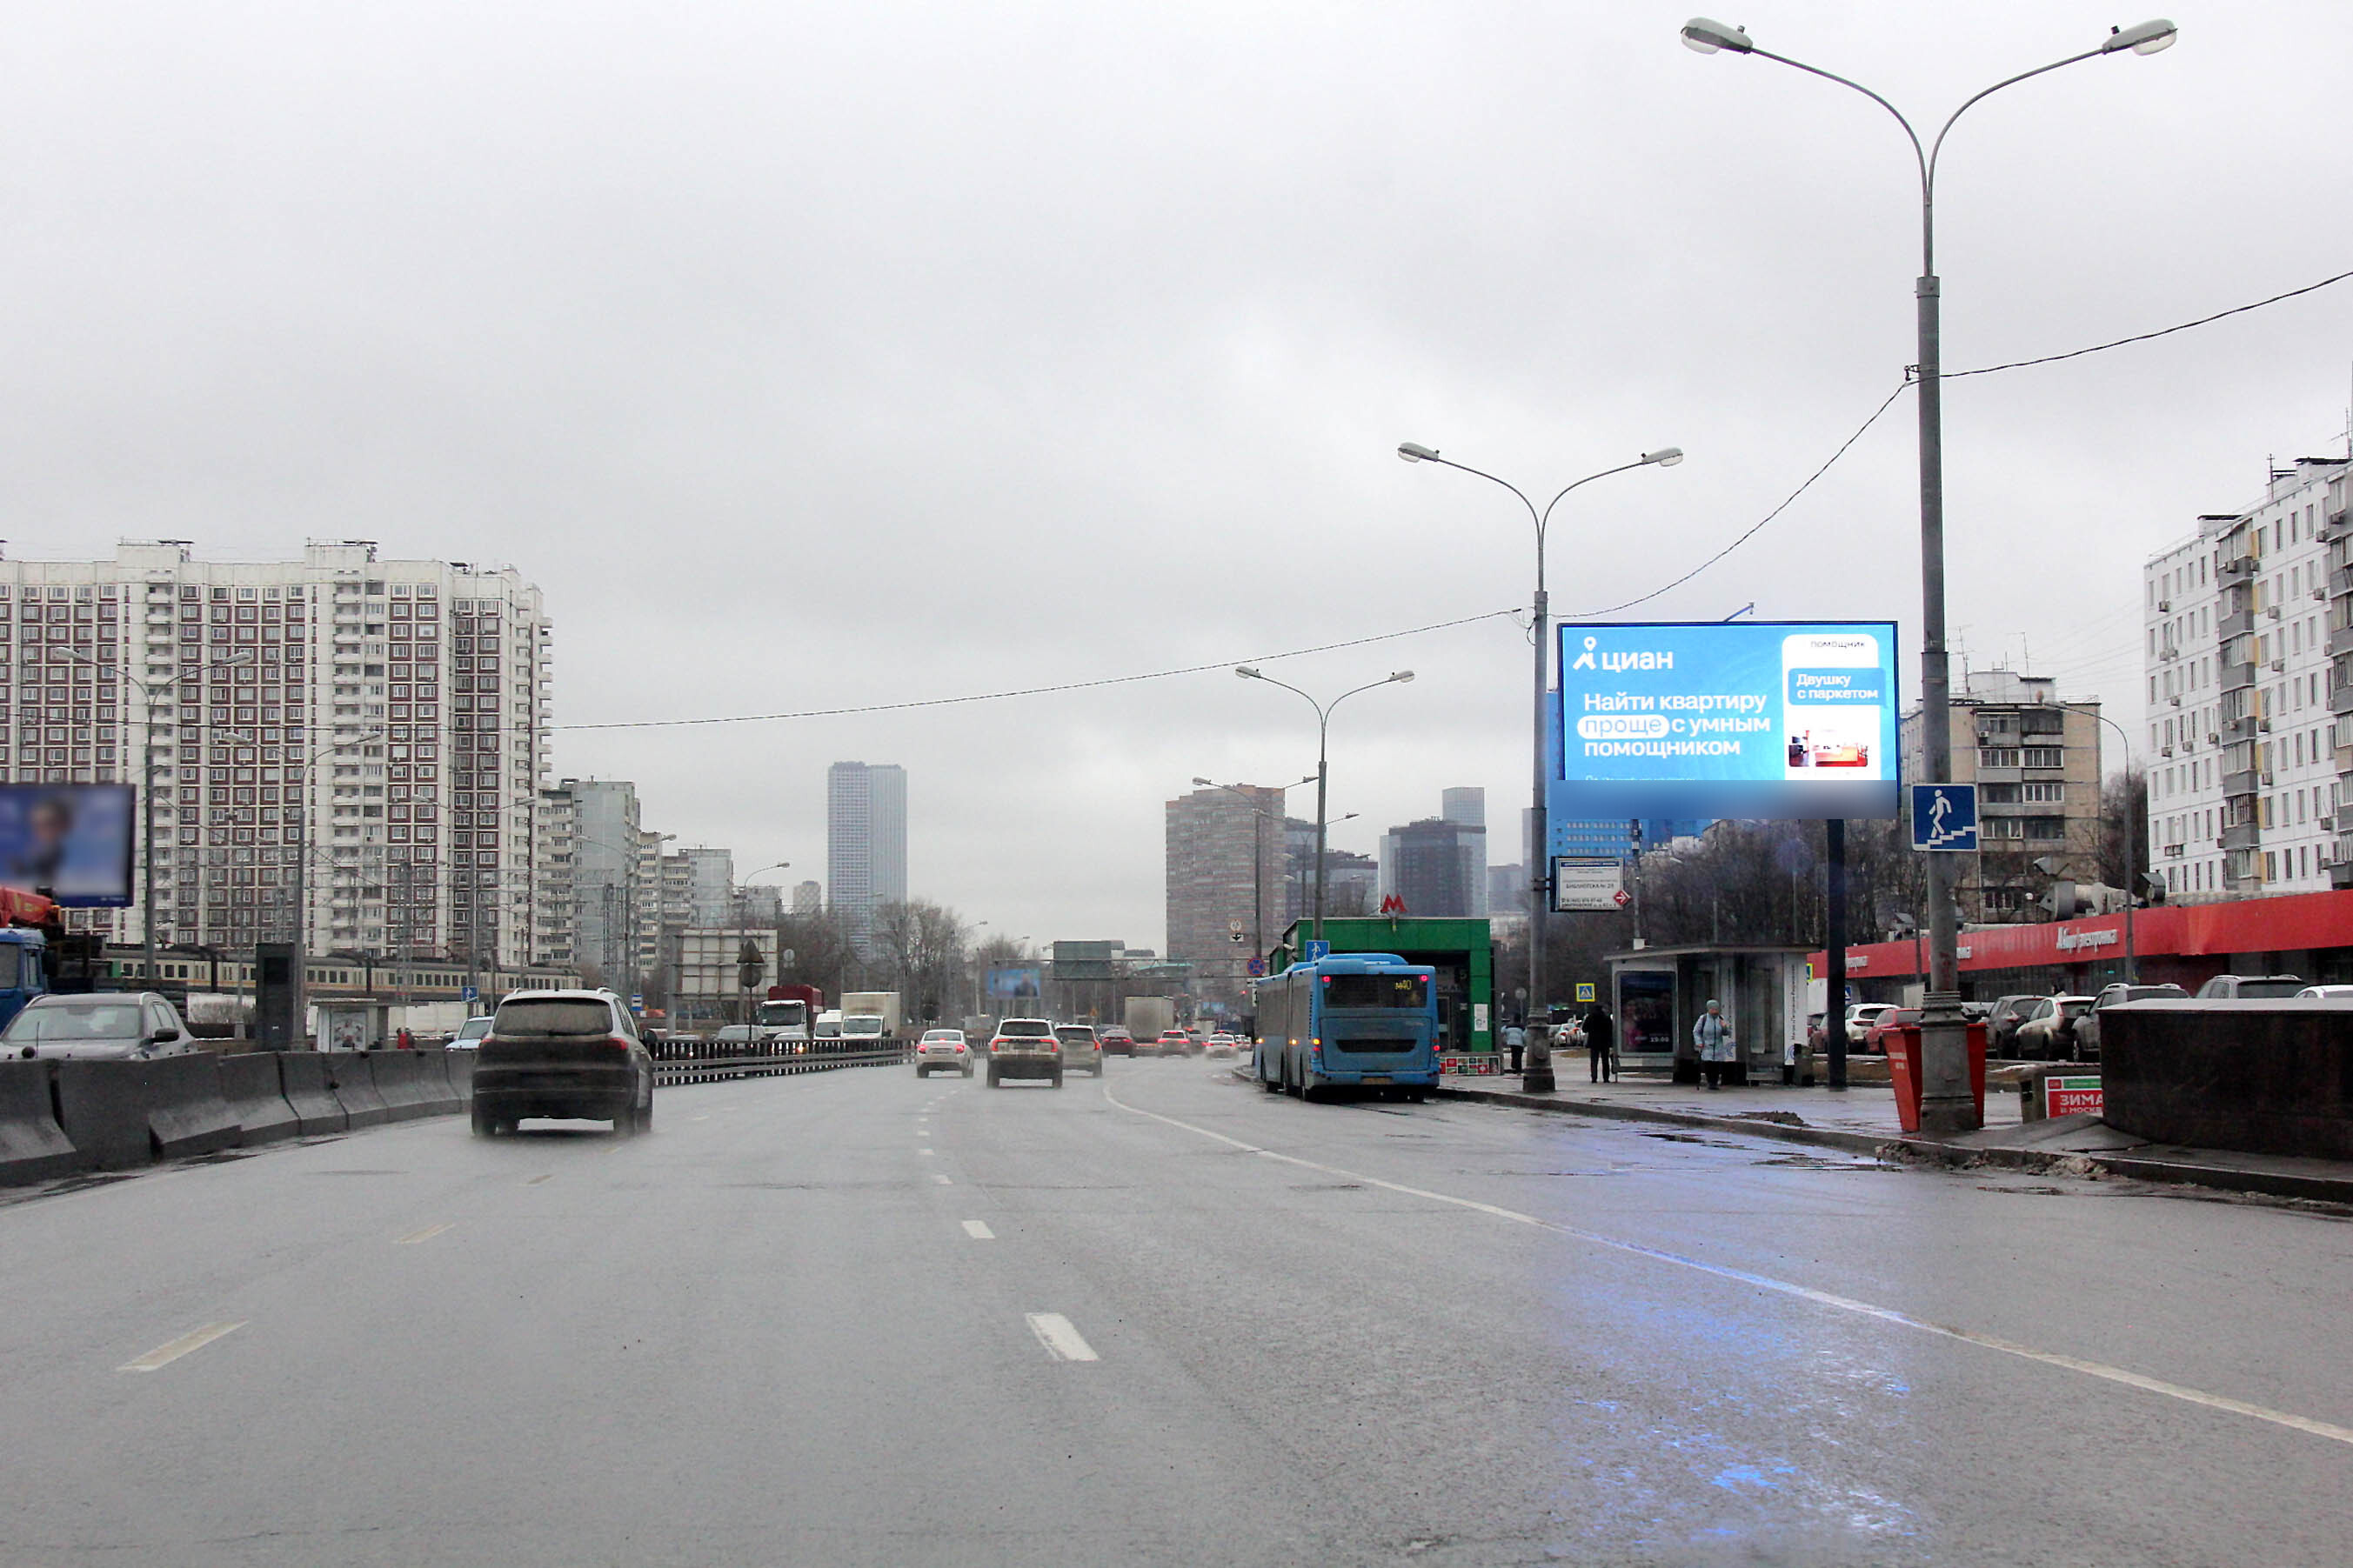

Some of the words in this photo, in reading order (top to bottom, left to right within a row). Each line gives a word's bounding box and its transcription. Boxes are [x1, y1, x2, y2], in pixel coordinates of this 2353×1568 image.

[1810, 640, 1865, 649] помощник
[1601, 648, 1674, 672] циан
[1795, 674, 1851, 688] Двушку
[1584, 692, 1654, 711] Найти
[1659, 693, 1768, 713] квартиру
[1796, 689, 1806, 699] с
[1808, 689, 1879, 701] паркетом
[1585, 718, 1662, 737] проще
[1671, 718, 1686, 733] с
[1688, 717, 1771, 736] умным
[1584, 740, 1741, 759] помощником
